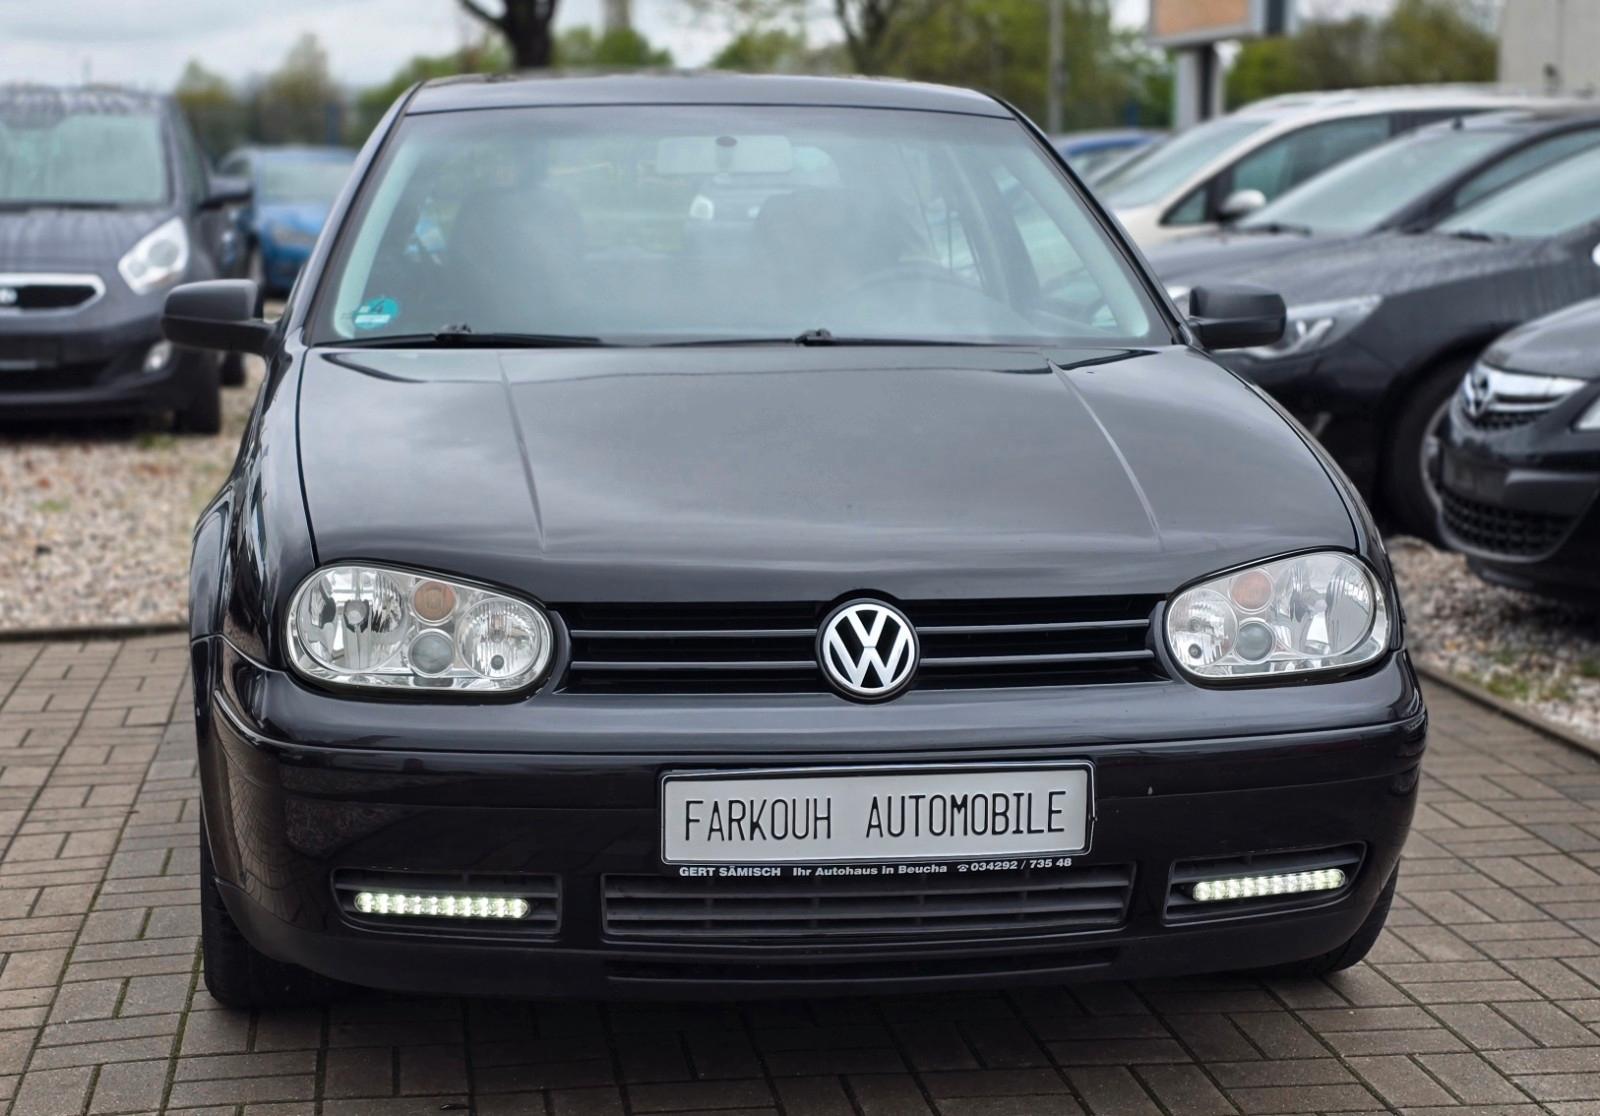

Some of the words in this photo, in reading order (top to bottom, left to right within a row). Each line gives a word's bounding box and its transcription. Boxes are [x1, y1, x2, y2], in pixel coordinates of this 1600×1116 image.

[824, 604, 915, 693] VW
[685, 798, 832, 841] FARKOUH
[866, 790, 1067, 838] AUTOMOBILE
[679, 867, 715, 877] GERT
[719, 865, 781, 877] SÄMISCH
[793, 867, 812, 876] Ihr
[815, 866, 878, 876] Autohaus
[882, 865, 894, 874] in
[898, 864, 947, 874] Beucha
[970, 861, 1018, 871] 034292
[1030, 859, 1053, 868] 735
[1056, 858, 1072, 867] 48
